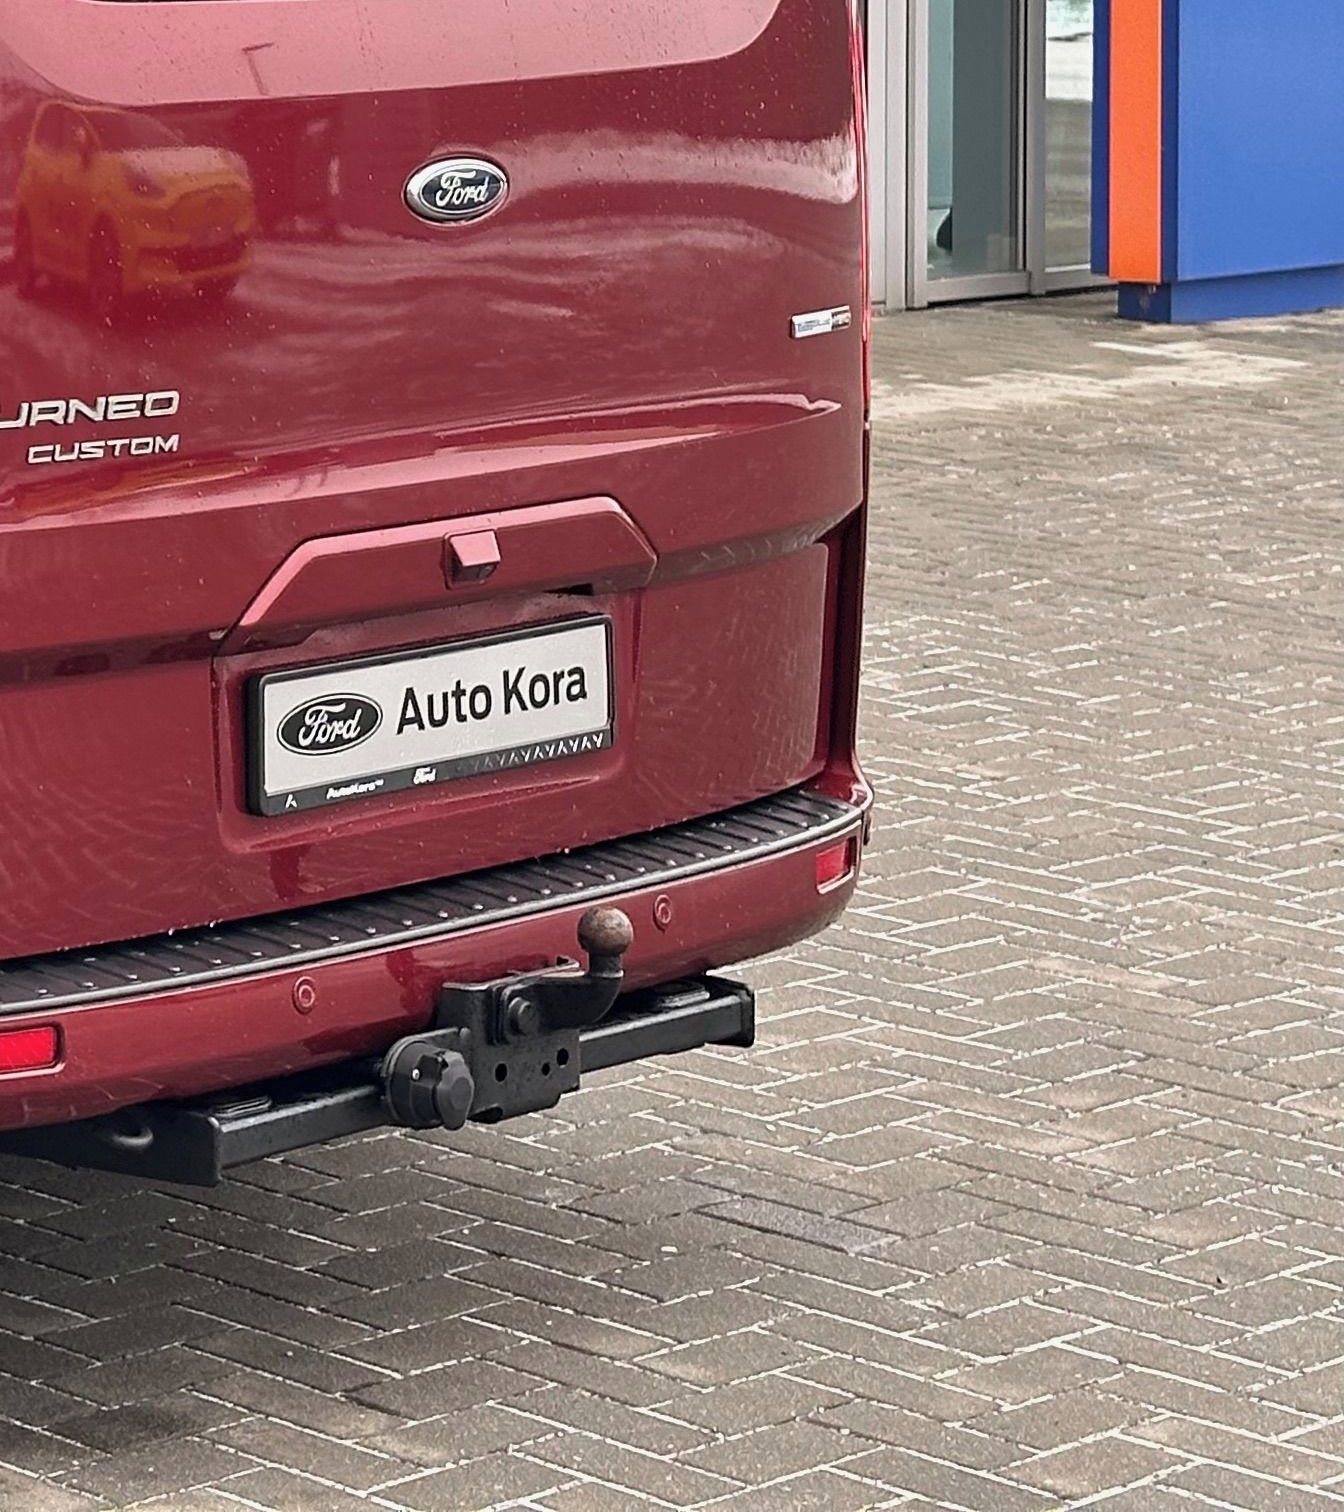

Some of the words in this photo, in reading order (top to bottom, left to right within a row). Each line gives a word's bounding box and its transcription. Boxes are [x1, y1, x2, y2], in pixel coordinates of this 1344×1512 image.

[435, 170, 490, 207] Ford
[27, 434, 180, 464] CUSTOM
[298, 701, 362, 748] Ford
[396, 679, 493, 736] Auto
[502, 665, 588, 716] Kora
